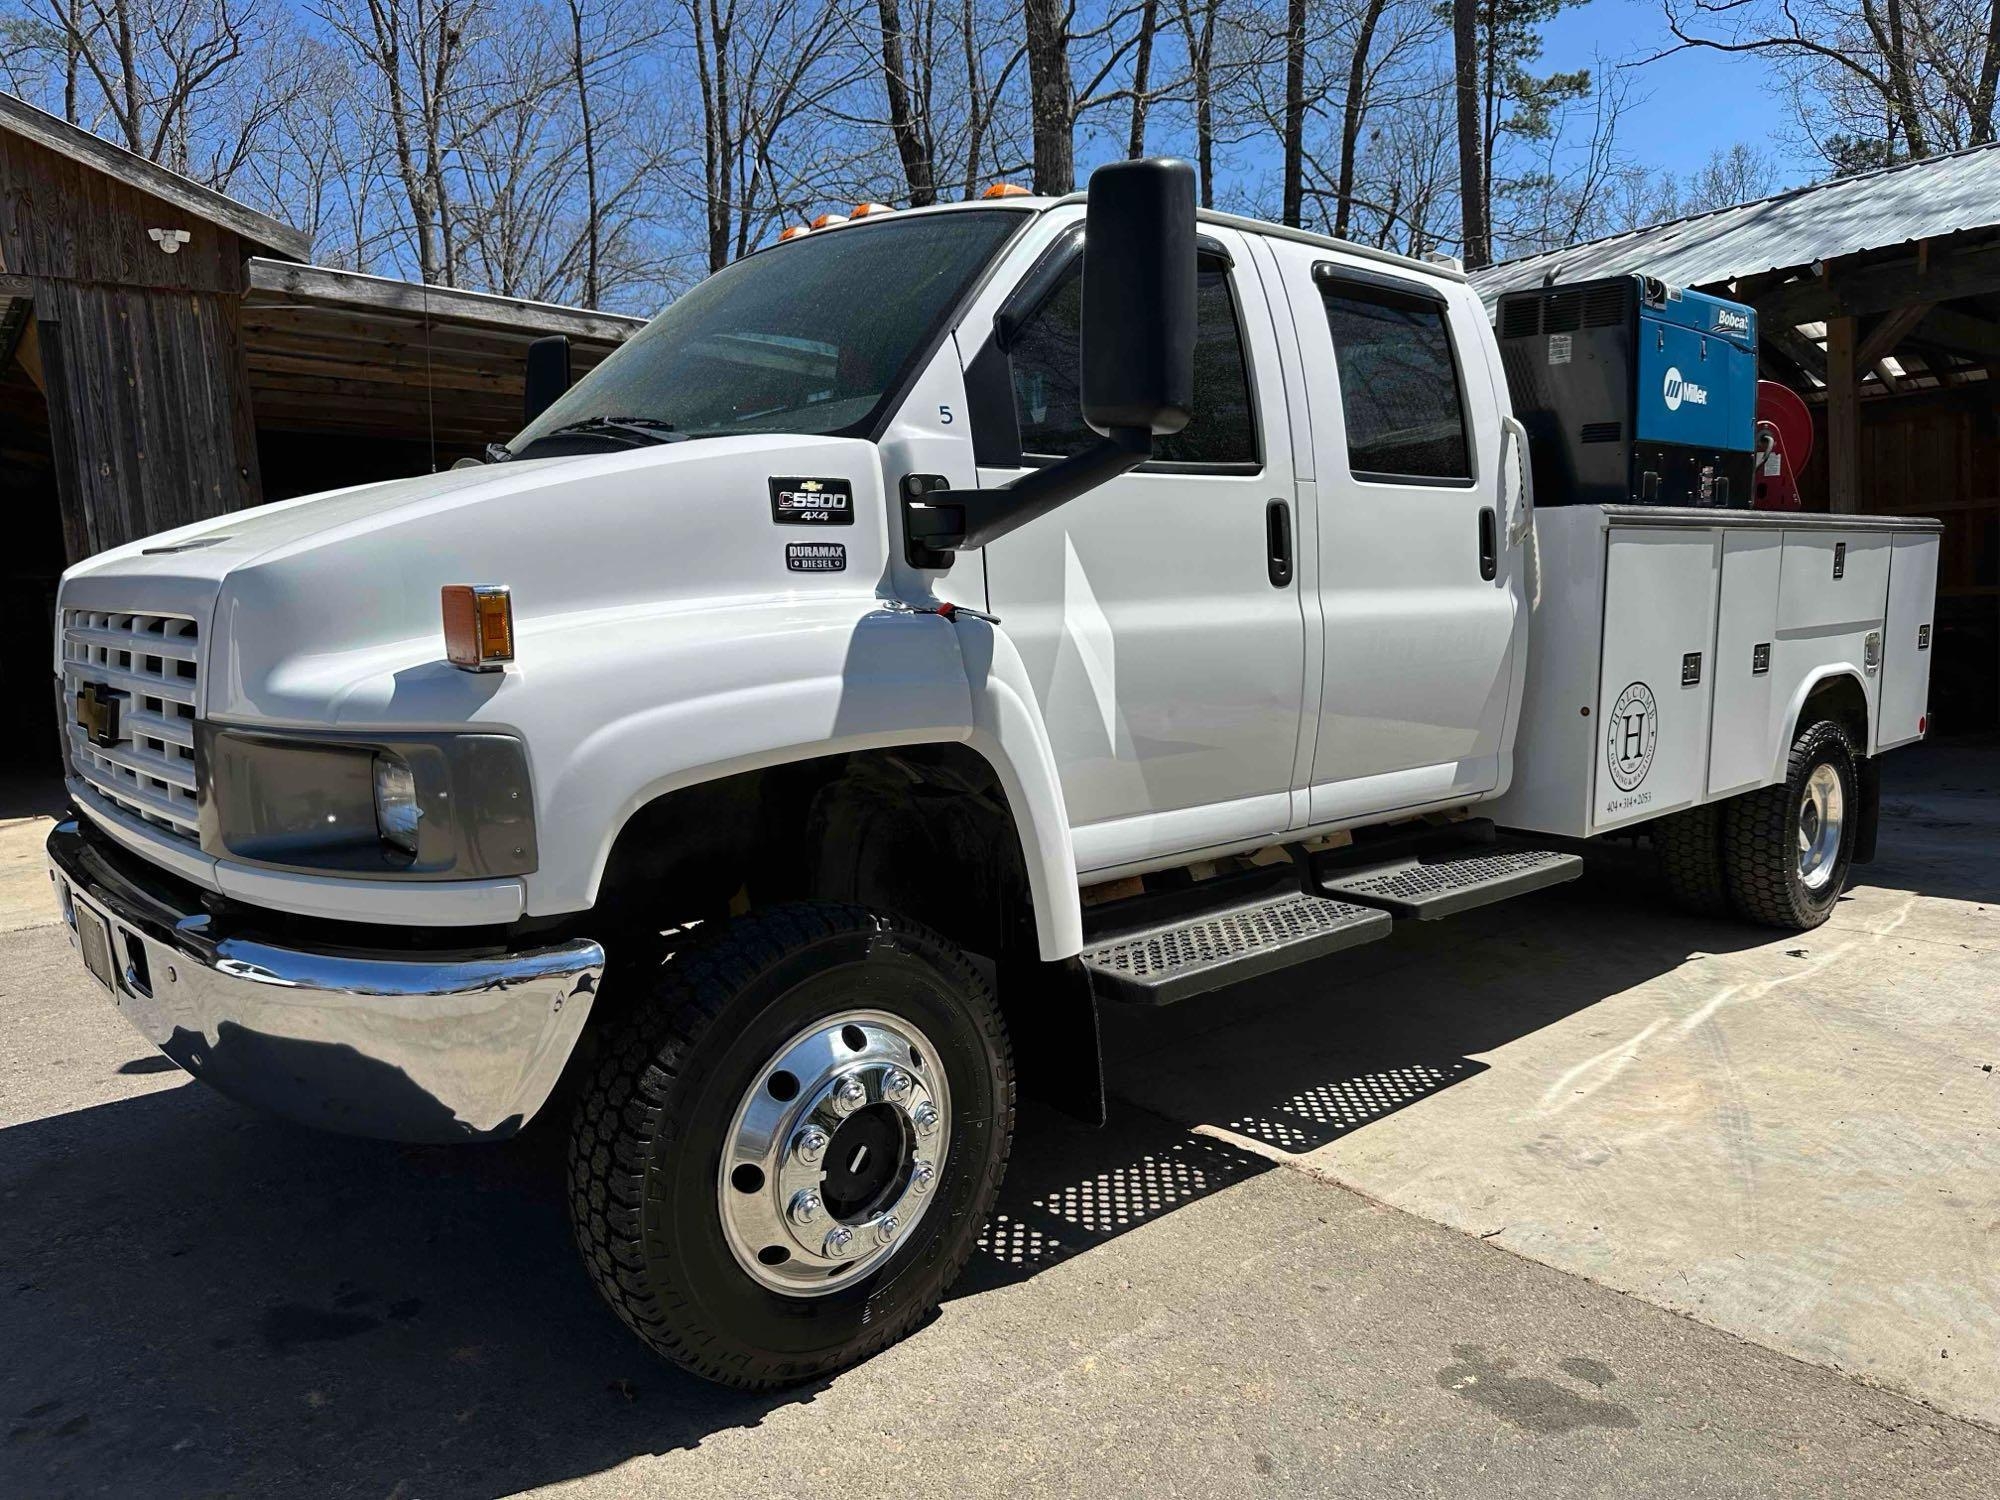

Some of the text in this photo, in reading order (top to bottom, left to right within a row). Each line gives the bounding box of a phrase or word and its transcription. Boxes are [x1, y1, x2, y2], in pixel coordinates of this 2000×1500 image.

[1718, 310, 1749, 329] Bobcat
[1683, 382, 1708, 405] Miller
[939, 405, 954, 425] 5
[778, 491, 847, 509] C5500
[789, 546, 843, 558] DURAMAX
[802, 560, 834, 568] DIESEL
[1612, 686, 1655, 726] HOLCOMB
[1620, 713, 1646, 761] H
